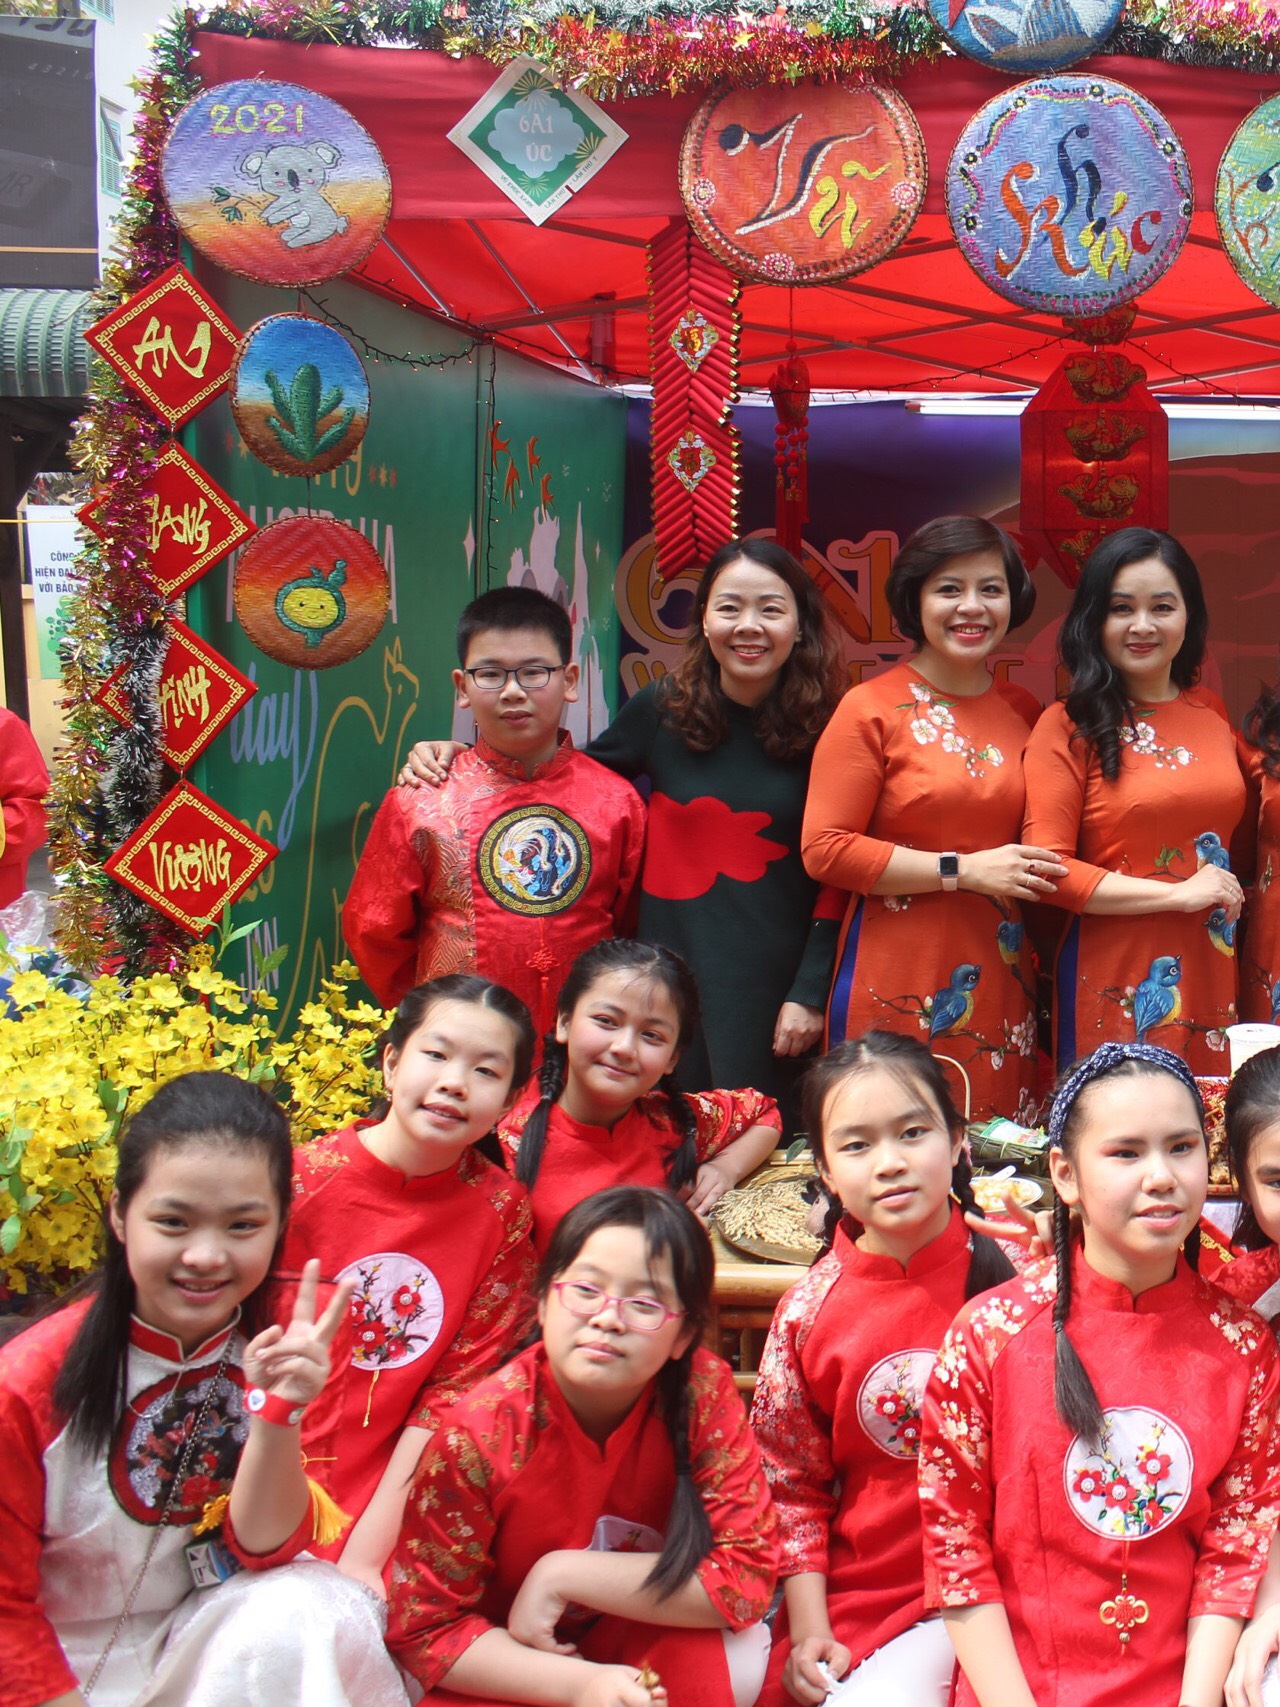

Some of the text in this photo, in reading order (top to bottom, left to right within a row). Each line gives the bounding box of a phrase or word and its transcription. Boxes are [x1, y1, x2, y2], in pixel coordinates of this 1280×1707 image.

[209, 103, 305, 135] 2021
[519, 113, 554, 134] 6A1
[525, 141, 553, 162] ÚC
[718, 112, 892, 250] Vũ
[994, 123, 1164, 282] Khúc
[133, 316, 211, 379] AN
[149, 838, 232, 893] VƯỢNG
